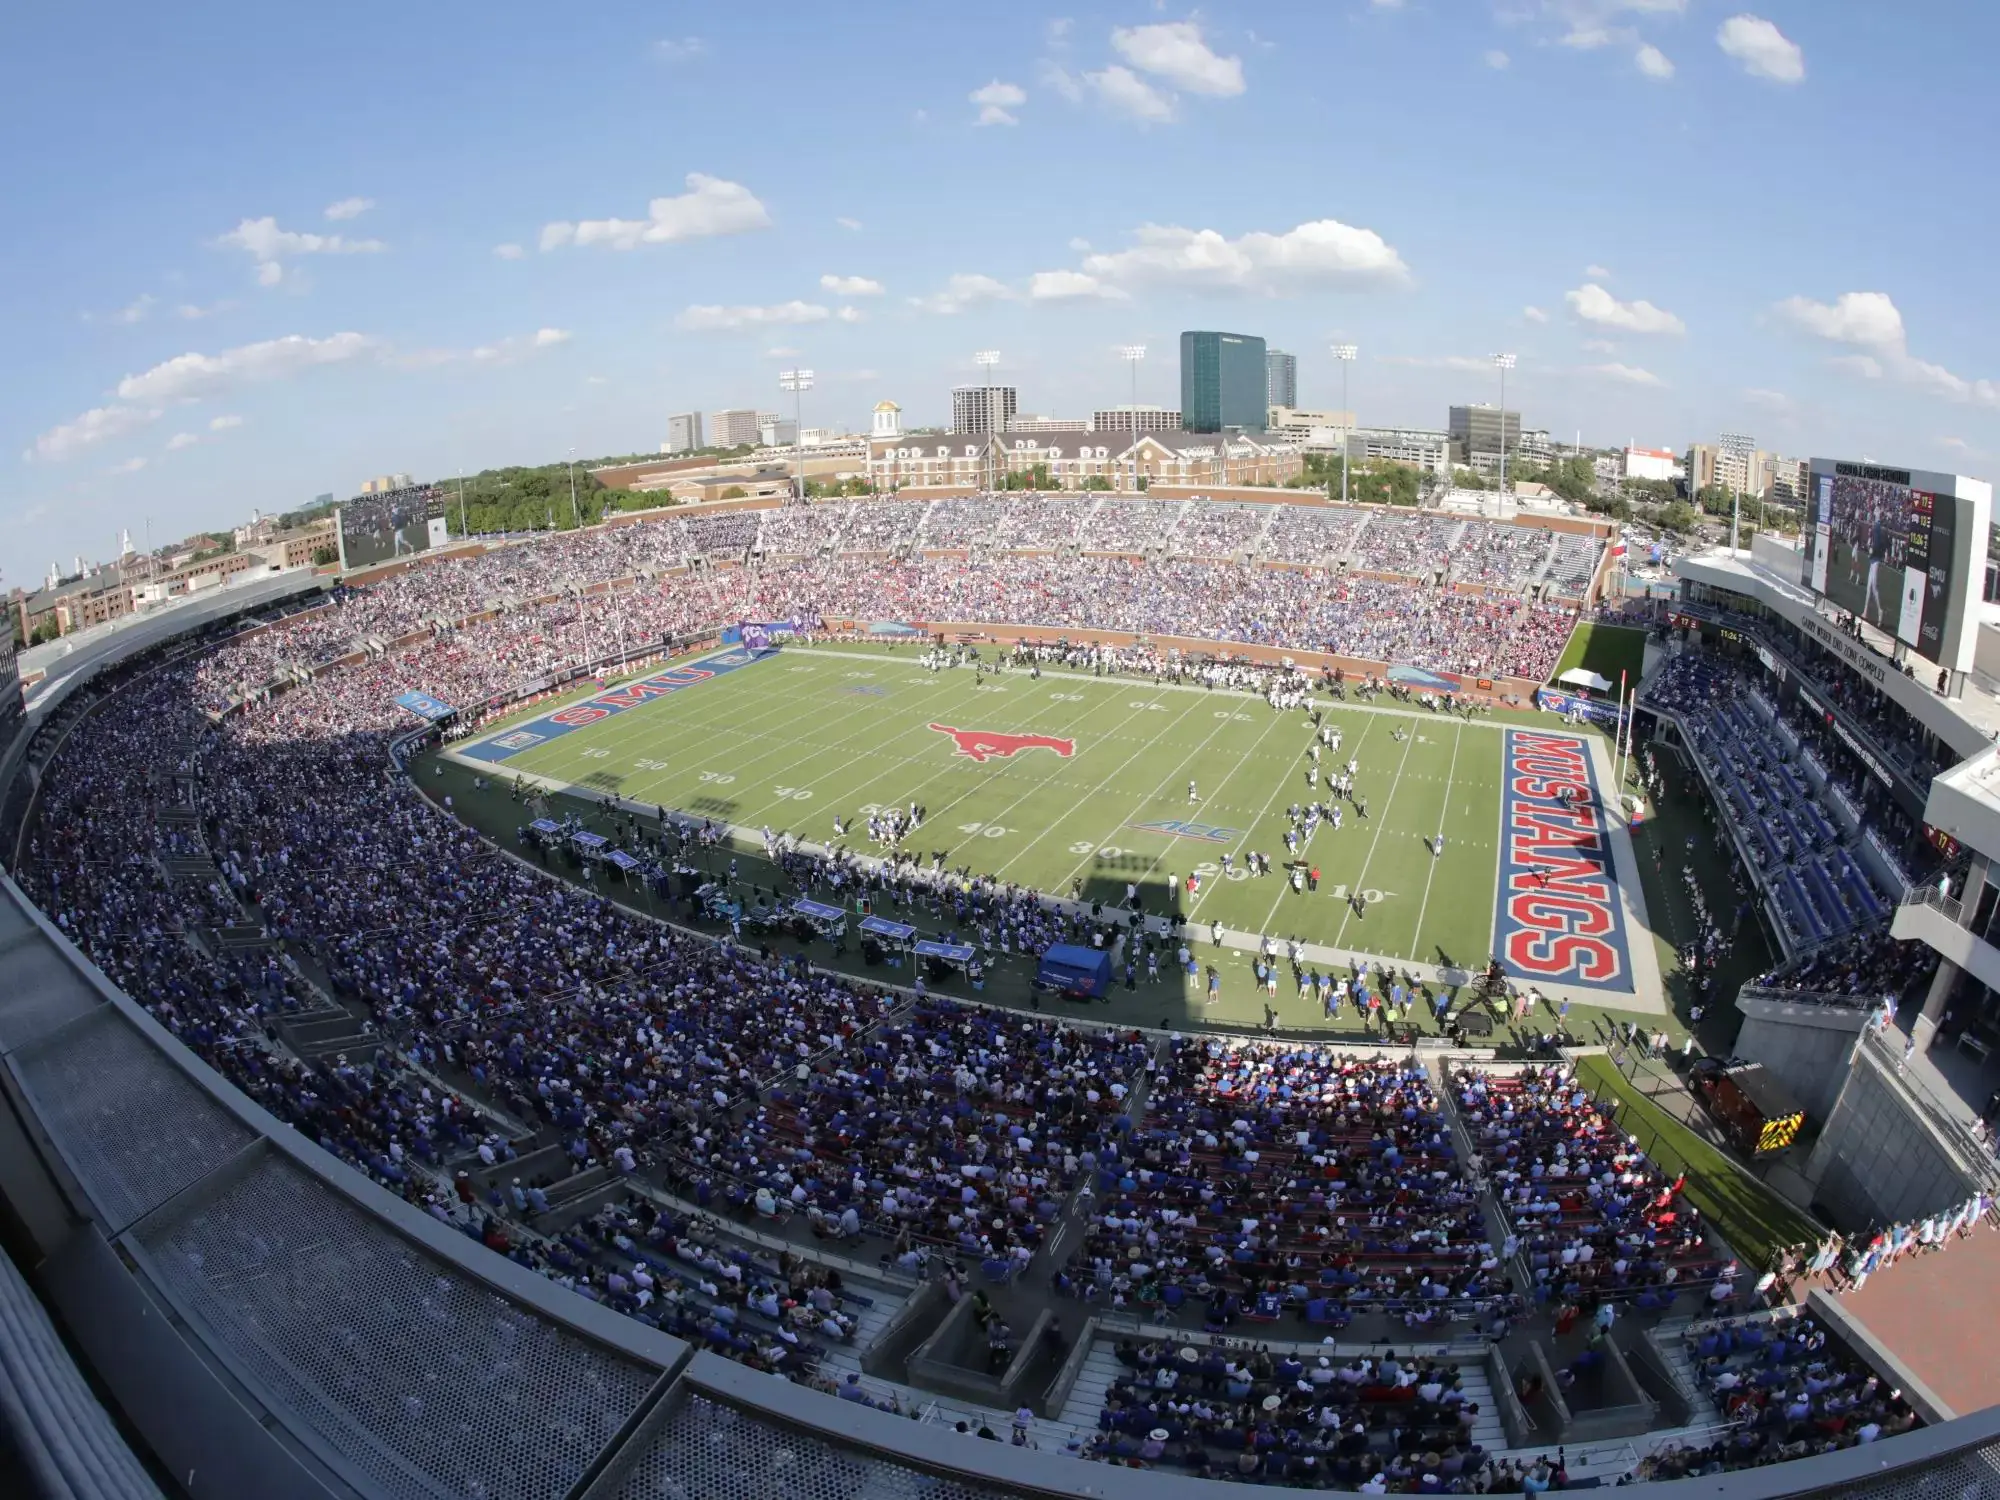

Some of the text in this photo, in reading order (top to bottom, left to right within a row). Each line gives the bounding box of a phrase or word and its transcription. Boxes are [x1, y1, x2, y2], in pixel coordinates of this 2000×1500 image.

[351, 494, 379, 506] GERALD
[384, 488, 403, 499] FORD
[403, 483, 431, 496] STADIUM
[1929, 566, 1946, 583] SMU
[1680, 617, 1689, 626] 17
[1832, 636, 1843, 652] END
[1844, 644, 1859, 663] ZONE
[1859, 655, 1886, 684] COMPLEX
[549, 667, 715, 726] SMU
[581, 747, 610, 758] 10
[634, 758, 667, 770] 20
[699, 770, 735, 784] 30
[773, 787, 813, 800] 40
[957, 822, 1005, 838] 40
[1140, 820, 1238, 841] ACC
[1938, 833, 1948, 849] 17
[1068, 841, 1122, 859] 30
[1505, 731, 1620, 982] MUSTANGS
[1194, 862, 1249, 881] 20
[1328, 885, 1385, 904] 10
